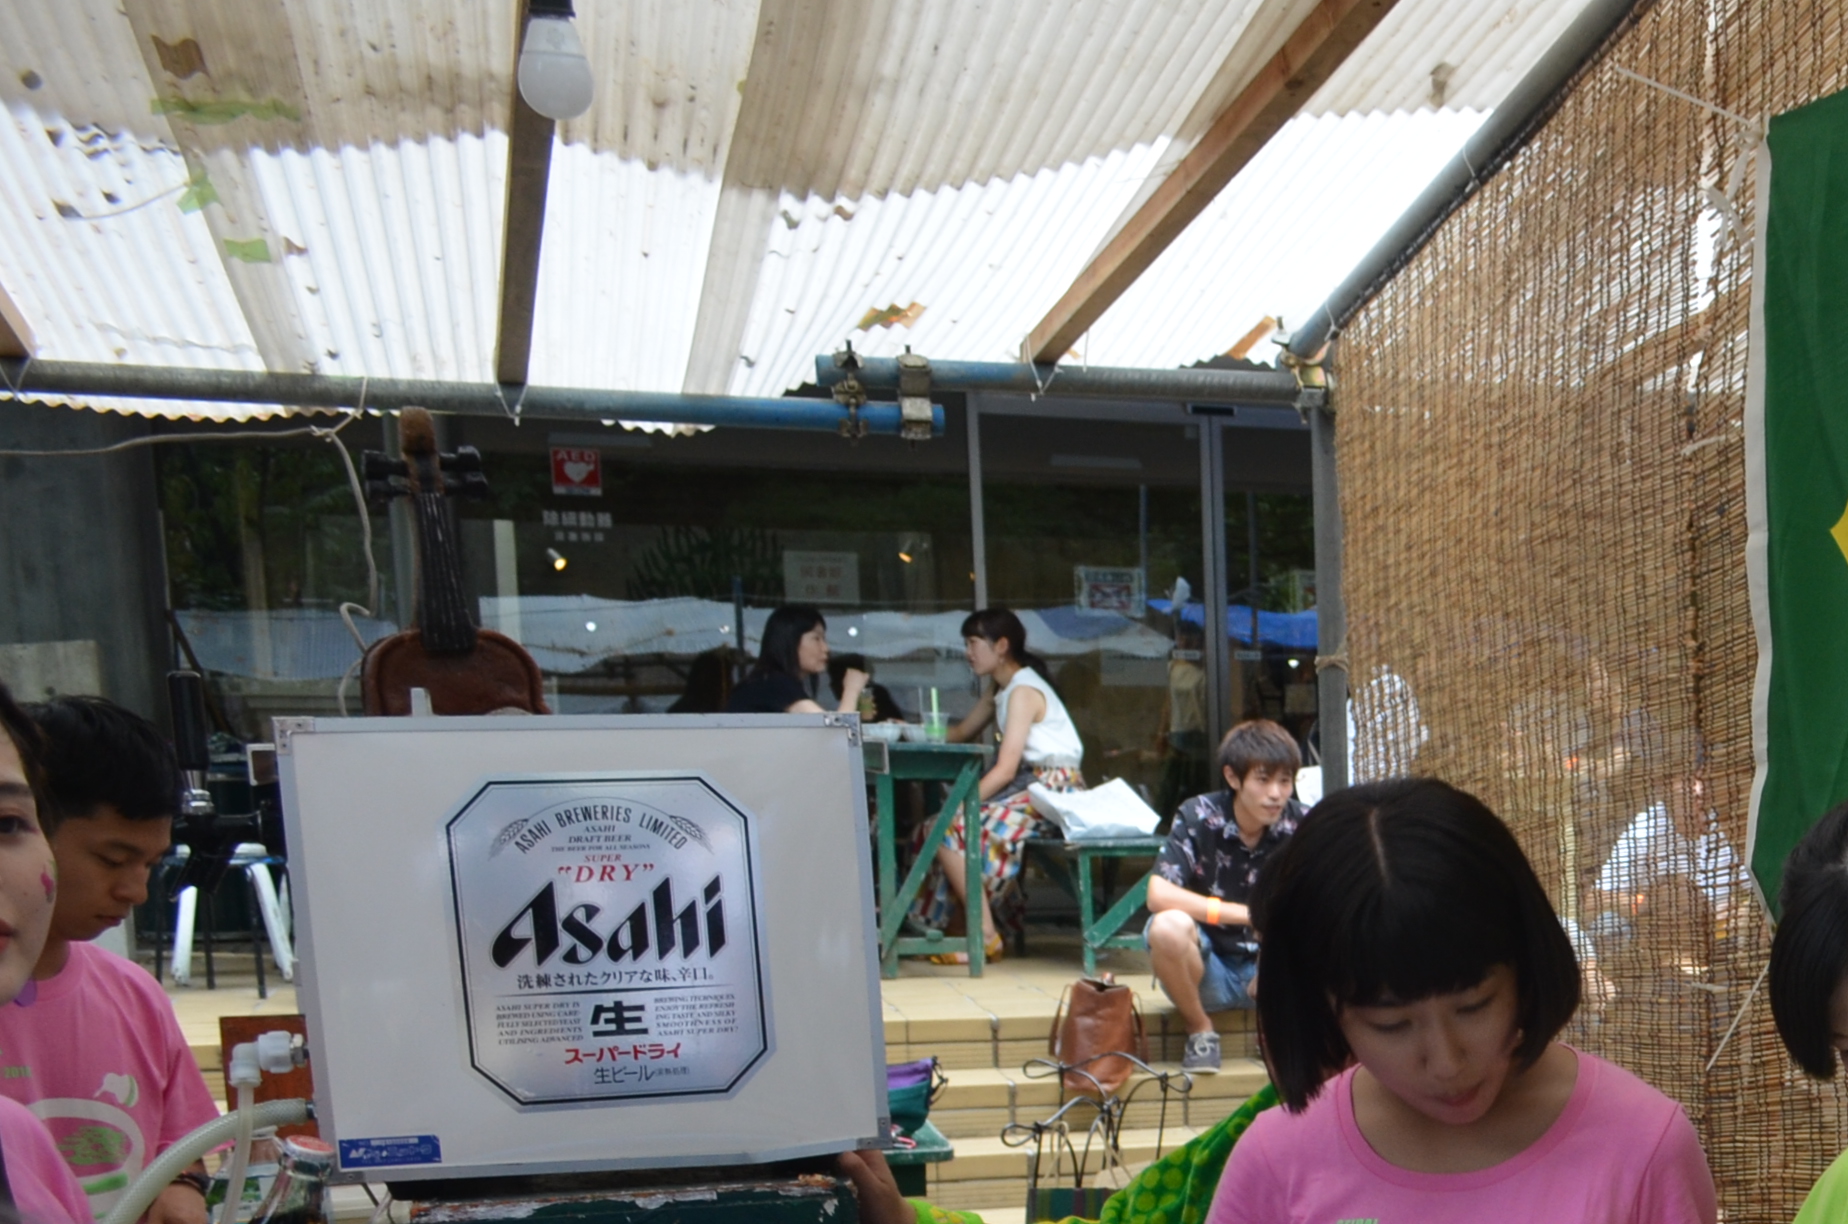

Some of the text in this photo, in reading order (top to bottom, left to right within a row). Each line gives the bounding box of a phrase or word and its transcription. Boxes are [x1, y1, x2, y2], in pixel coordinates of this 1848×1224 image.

[556, 450, 597, 461] AED
[514, 805, 689, 854] ASAHI BREWERIES LIMITED
[583, 824, 616, 833] ASAHI
[568, 834, 632, 844] DRAFT BEER
[584, 853, 622, 863] SUPER
[491, 874, 727, 968] Asahi
[496, 1004, 522, 1012] ASAHI
[523, 1002, 550, 1011] SUPER
[590, 1000, 649, 1037] 生
[564, 1042, 682, 1065] スーパードライ
[594, 1065, 654, 1085] 生ビール
